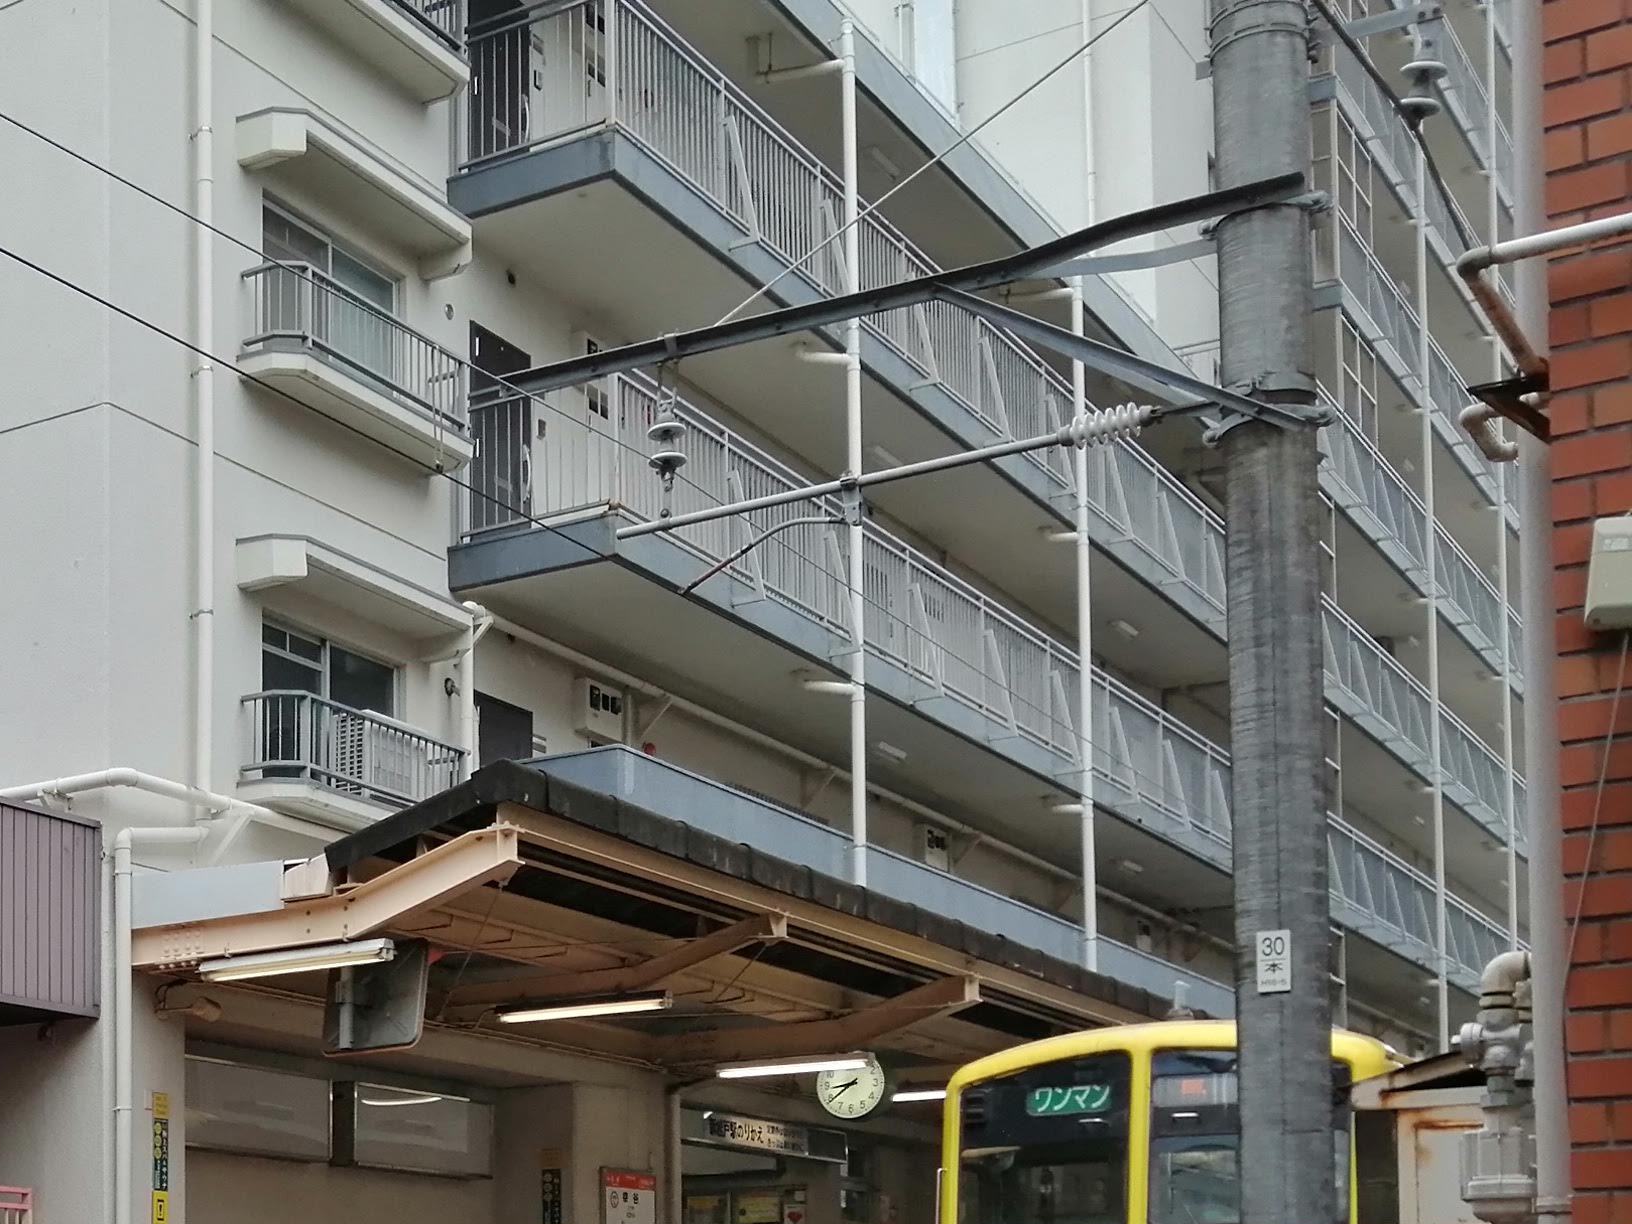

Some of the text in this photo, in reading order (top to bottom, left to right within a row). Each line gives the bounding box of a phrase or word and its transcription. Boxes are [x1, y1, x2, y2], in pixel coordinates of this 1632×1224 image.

[1262, 936, 1285, 956] 30
[1265, 962, 1284, 974] 本
[1035, 1085, 1110, 1112] ワンマン
